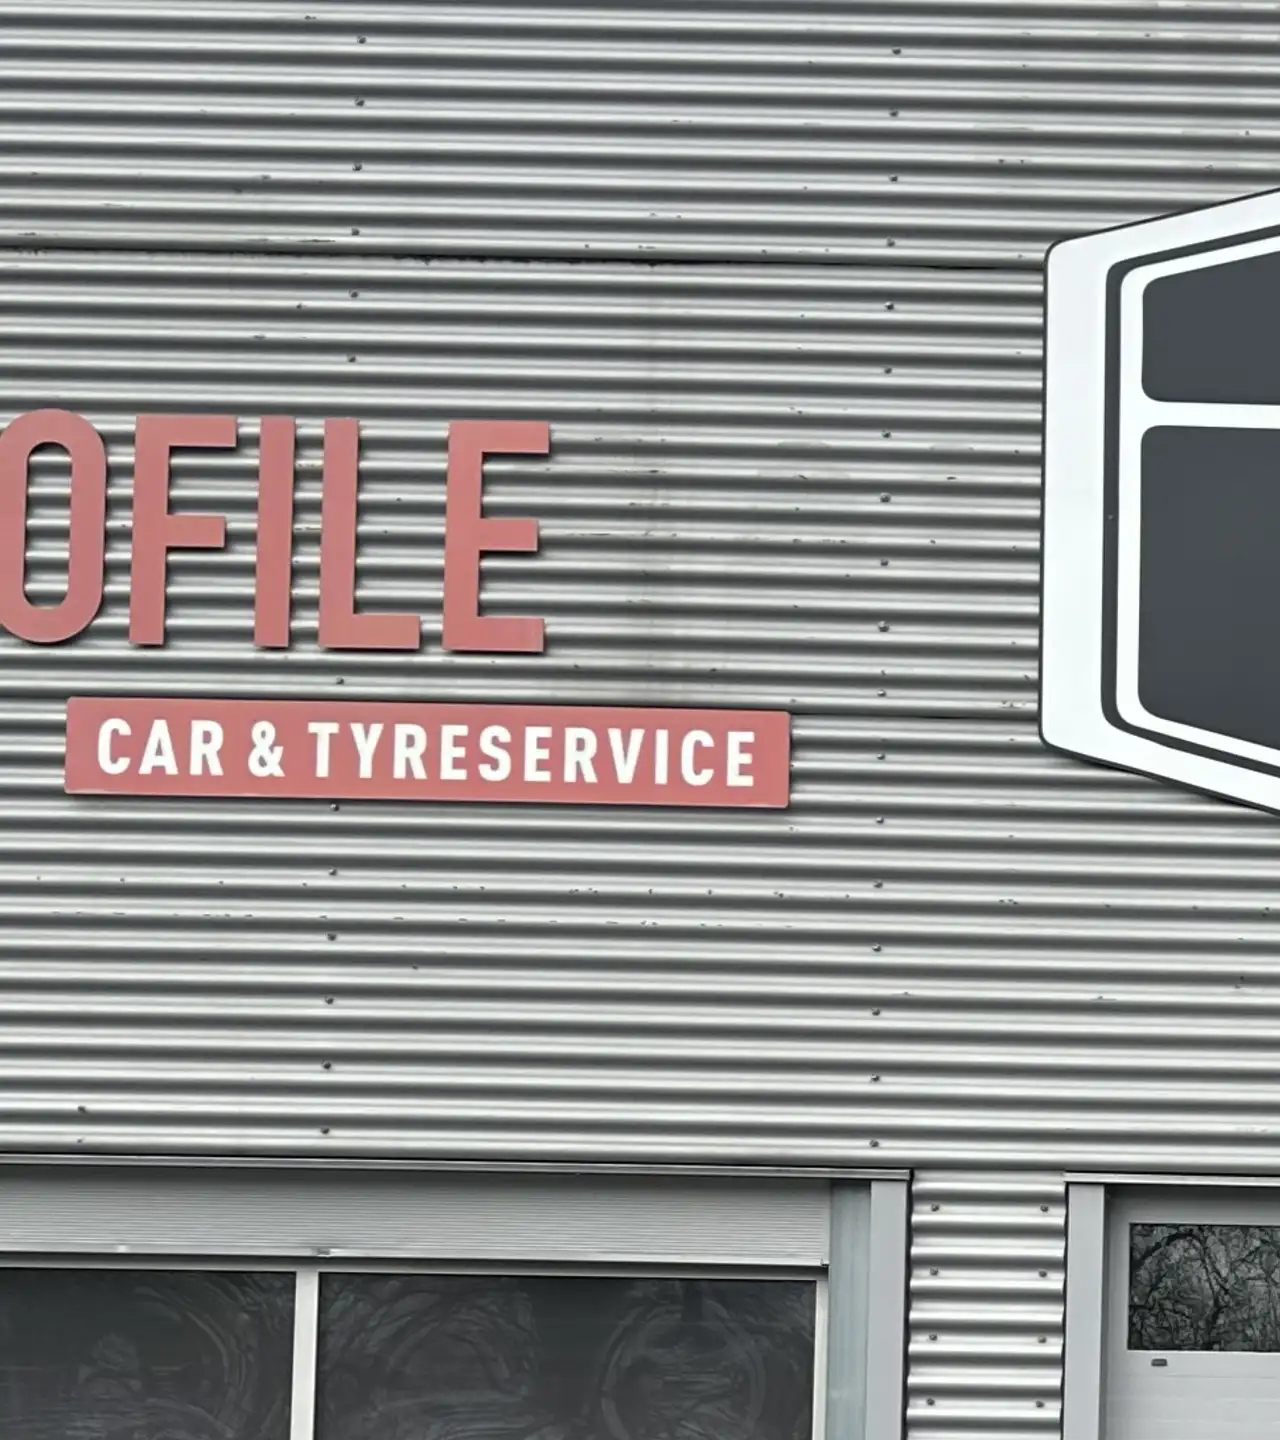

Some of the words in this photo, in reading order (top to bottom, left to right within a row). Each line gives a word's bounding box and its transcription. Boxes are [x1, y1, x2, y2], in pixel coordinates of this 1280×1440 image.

[0, 407, 552, 655] OFILE
[98, 718, 223, 775] CAR
[248, 721, 285, 777] &
[308, 722, 754, 786] TYRESERVICE
